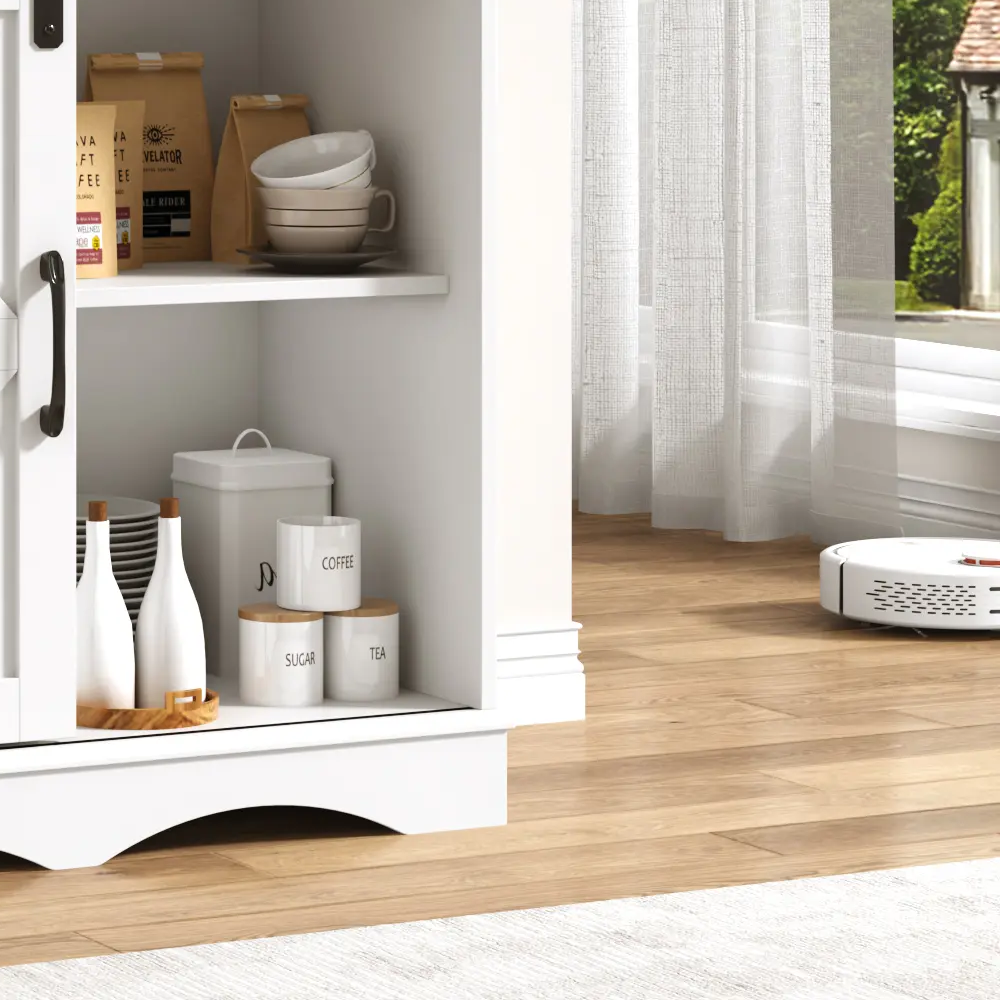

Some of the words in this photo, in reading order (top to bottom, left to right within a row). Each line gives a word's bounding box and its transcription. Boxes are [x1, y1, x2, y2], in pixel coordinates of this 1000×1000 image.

[141, 149, 182, 164] VELATOR
[159, 196, 186, 207] RIDER
[322, 555, 354, 570] COFFEE
[285, 652, 316, 667] SUGAR
[370, 646, 386, 660] TEA
